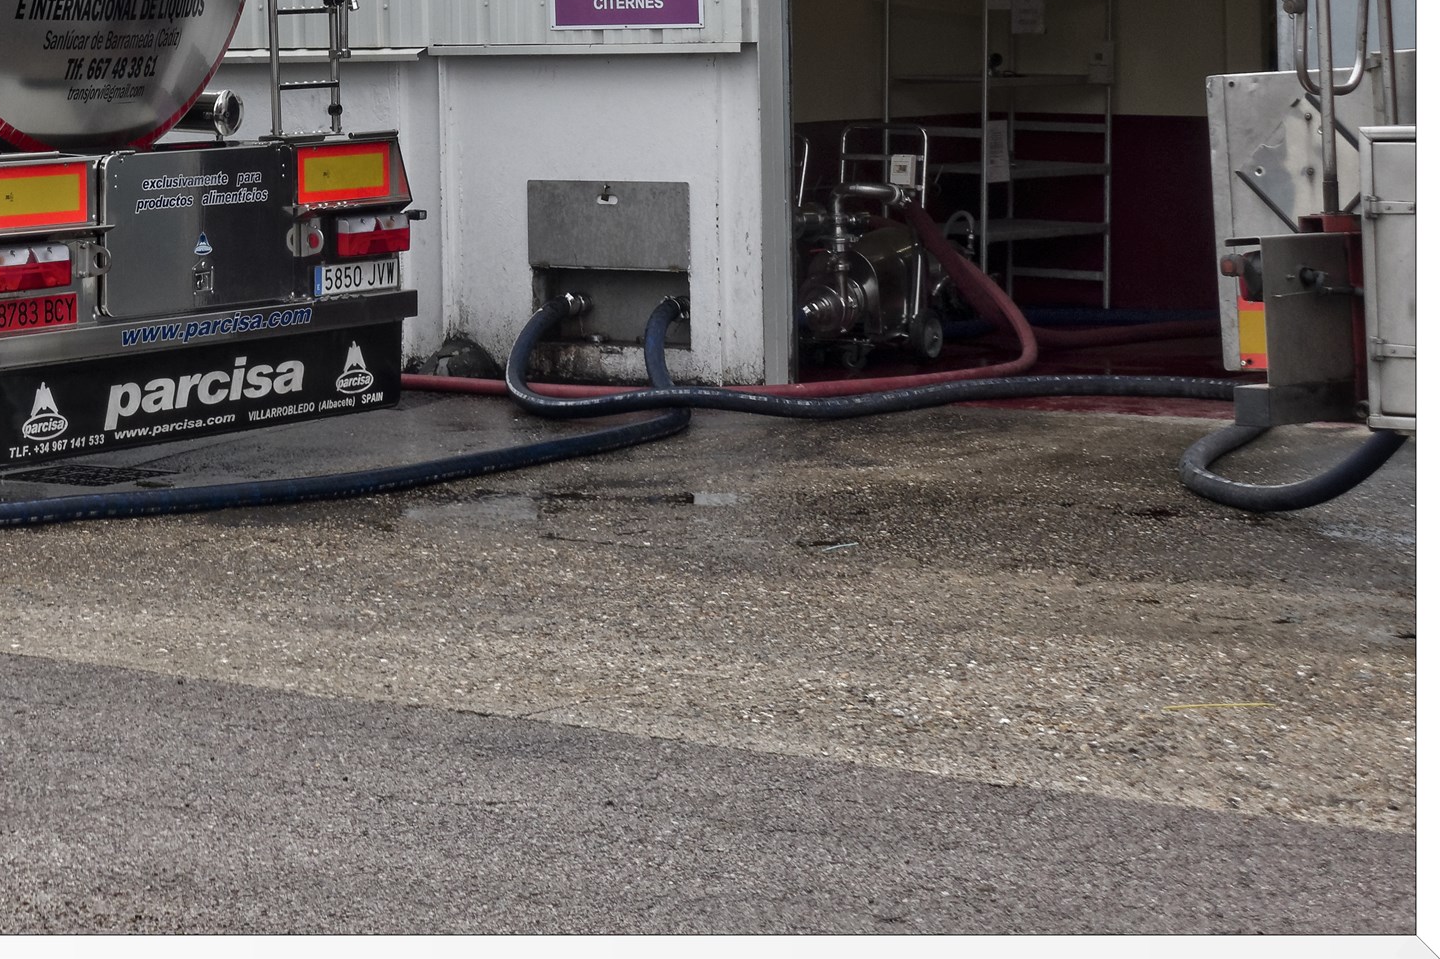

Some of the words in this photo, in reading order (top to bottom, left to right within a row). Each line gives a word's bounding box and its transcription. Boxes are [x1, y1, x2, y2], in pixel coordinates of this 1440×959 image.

[43, 30, 89, 50] Sanlúcar
[90, 31, 103, 50] de
[104, 30, 154, 50] Barrameda
[64, 58, 83, 81] Tlf.
[87, 58, 112, 80] 667
[111, 57, 127, 79] 48
[128, 56, 142, 78] 38
[144, 54, 159, 76] 61
[67, 83, 145, 104] transjorvi@gmail.com
[142, 171, 229, 190] exclusivamente
[236, 171, 262, 187] para
[135, 193, 194, 214] productos
[202, 187, 268, 206] alimenticios
[325, 265, 362, 290] 5850
[368, 262, 395, 286] JVW
[44, 297, 74, 323] BCY
[122, 306, 312, 346] www.parcisa.com
[104, 356, 305, 431] parcisa
[337, 374, 371, 392] parcisa
[248, 403, 315, 422] VILLARROBLEDO
[318, 396, 356, 413] (Albacete)
[361, 391, 384, 405] SPAIN
[23, 418, 64, 438] parcisa
[114, 413, 236, 440] www.parcisa.com
[9, 445, 31, 459] TLF.
[33, 442, 50, 454] +34
[51, 439, 68, 452] 967
[70, 436, 86, 449] 141
[88, 433, 105, 446] 533
